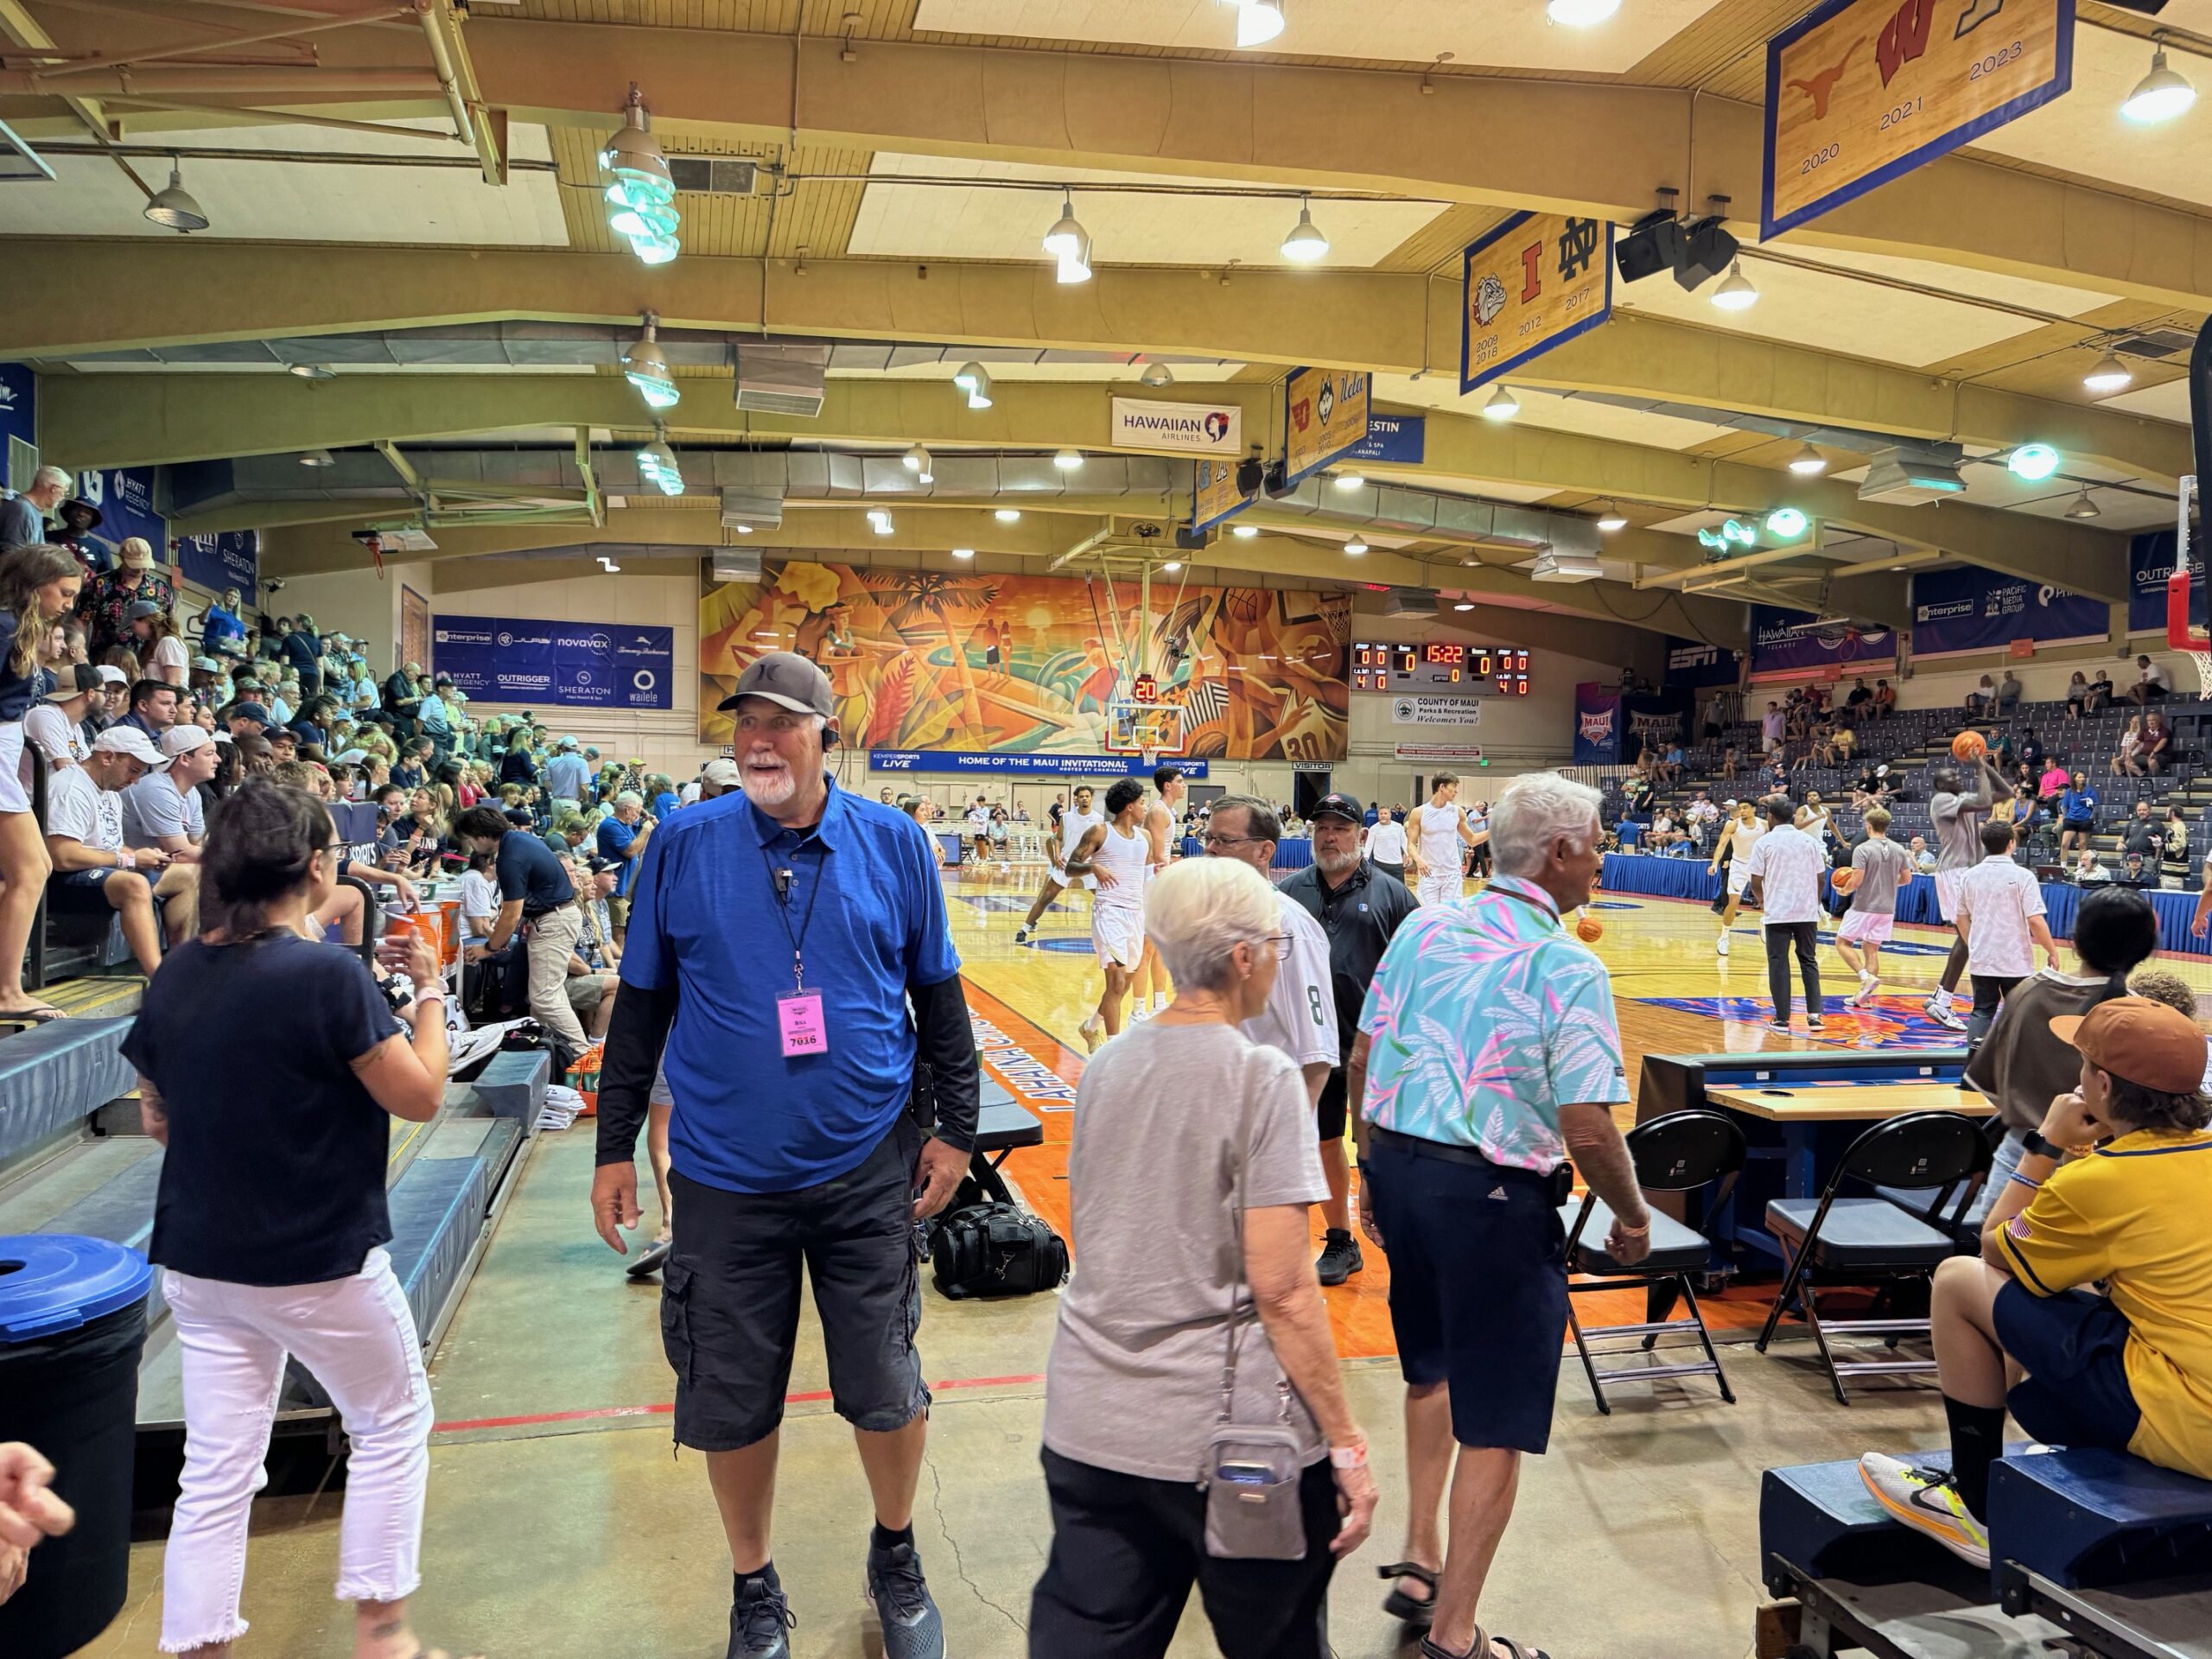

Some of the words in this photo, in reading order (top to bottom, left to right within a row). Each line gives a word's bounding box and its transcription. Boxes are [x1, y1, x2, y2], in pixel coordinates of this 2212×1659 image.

[1968, 41, 2023, 82] 2023
[1879, 96, 1923, 130] 2021
[1801, 143, 1840, 175] 2020
[1565, 288, 1590, 310] 2017
[1519, 316, 1541, 336] 2012
[1476, 334, 1498, 353] 2009
[1476, 347, 1498, 365] 2018
[1123, 415, 1201, 432] HAWAIIAN
[1369, 421, 1400, 433] ESTIN
[1161, 432, 1201, 442] AIRLINES
[1318, 441, 1331, 454] 2010
[125, 477, 146, 496] HYATT
[125, 490, 150, 511] REGENCY
[223, 548, 255, 575] SHERATON
[2002, 585, 2027, 595] PACIFIC
[2002, 594, 2023, 605] MEDIA
[1920, 603, 1972, 618] enterprise
[2002, 603, 2024, 614] GROUP
[439, 632, 491, 641] enterprise
[557, 639, 608, 648] novavax
[1362, 651, 1370, 664] 0
[1377, 652, 1385, 664] 0
[1427, 645, 1463, 663] 15:22
[1669, 645, 1718, 670] ESPN
[1406, 654, 1415, 671] 0
[1480, 657, 1490, 674] 0
[1503, 657, 1511, 670] 0
[1519, 657, 1527, 671] 0
[498, 674, 550, 683] OUTRIGGER
[1357, 676, 1365, 688] 4
[1377, 676, 1386, 690] 0
[1452, 669, 1459, 683] 0
[558, 686, 611, 695] SHERATON
[1135, 682, 1156, 699] 20
[1500, 681, 1507, 693] 4
[1519, 681, 1527, 694] 0
[629, 691, 658, 702] wailele
[1584, 716, 1610, 728] MAUI
[1637, 717, 1676, 728] MAUI
[1287, 732, 1324, 761] 30
[992, 757, 1007, 766] OF
[1033, 759, 1058, 767] MAUI
[1061, 760, 1128, 768] INVITATIONAL
[1306, 985, 1324, 1027] 8
[790, 1035, 817, 1046] 7016
